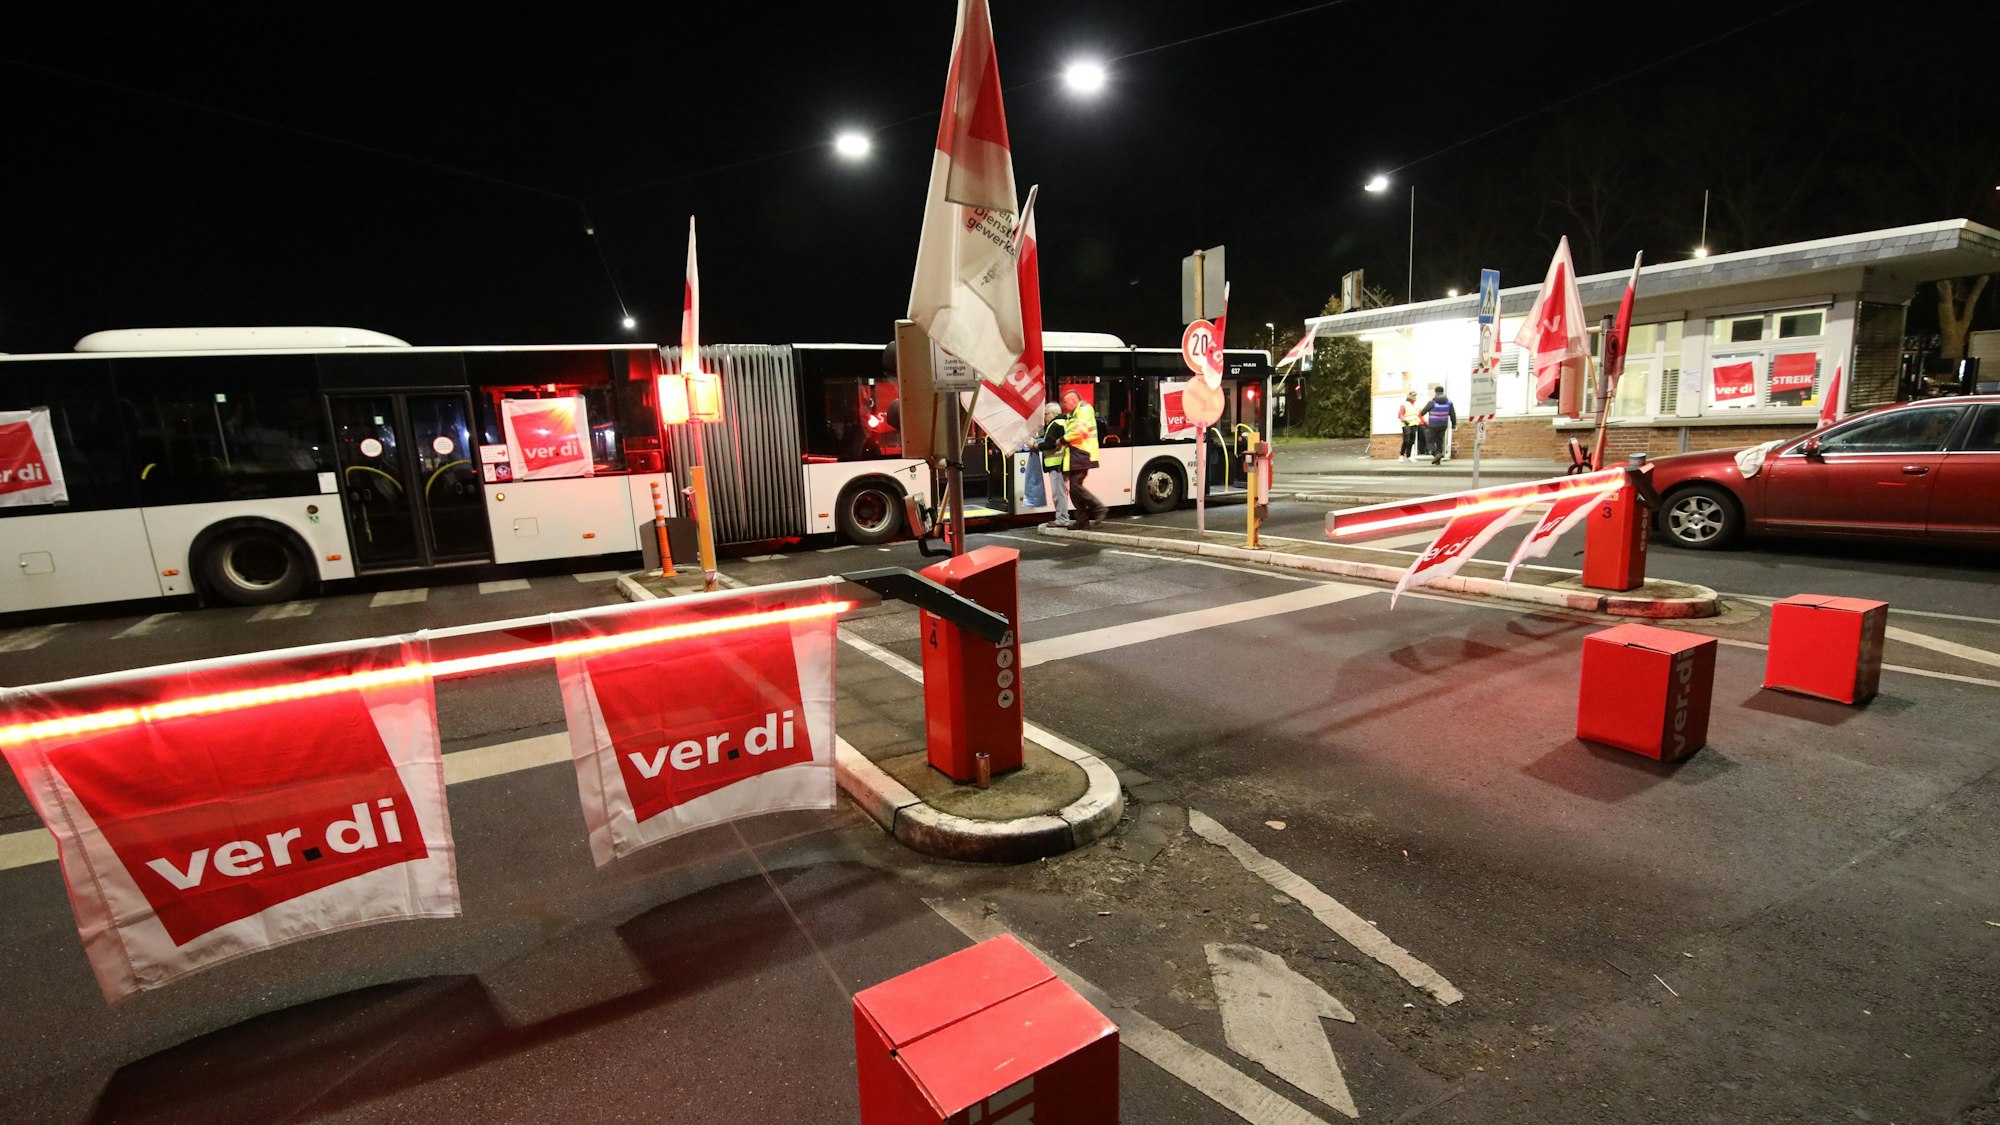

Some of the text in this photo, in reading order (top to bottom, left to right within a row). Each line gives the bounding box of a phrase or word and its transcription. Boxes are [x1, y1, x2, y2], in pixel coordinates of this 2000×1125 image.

[1192, 333, 1208, 357] 20
[1772, 375, 1814, 385] STREIK
[525, 439, 579, 460] ver.di
[1602, 506, 1612, 519] 3
[930, 629, 938, 650] 4
[1672, 646, 1697, 757] ver.di
[628, 709, 796, 780] ver.di
[145, 797, 403, 891] ver.di
